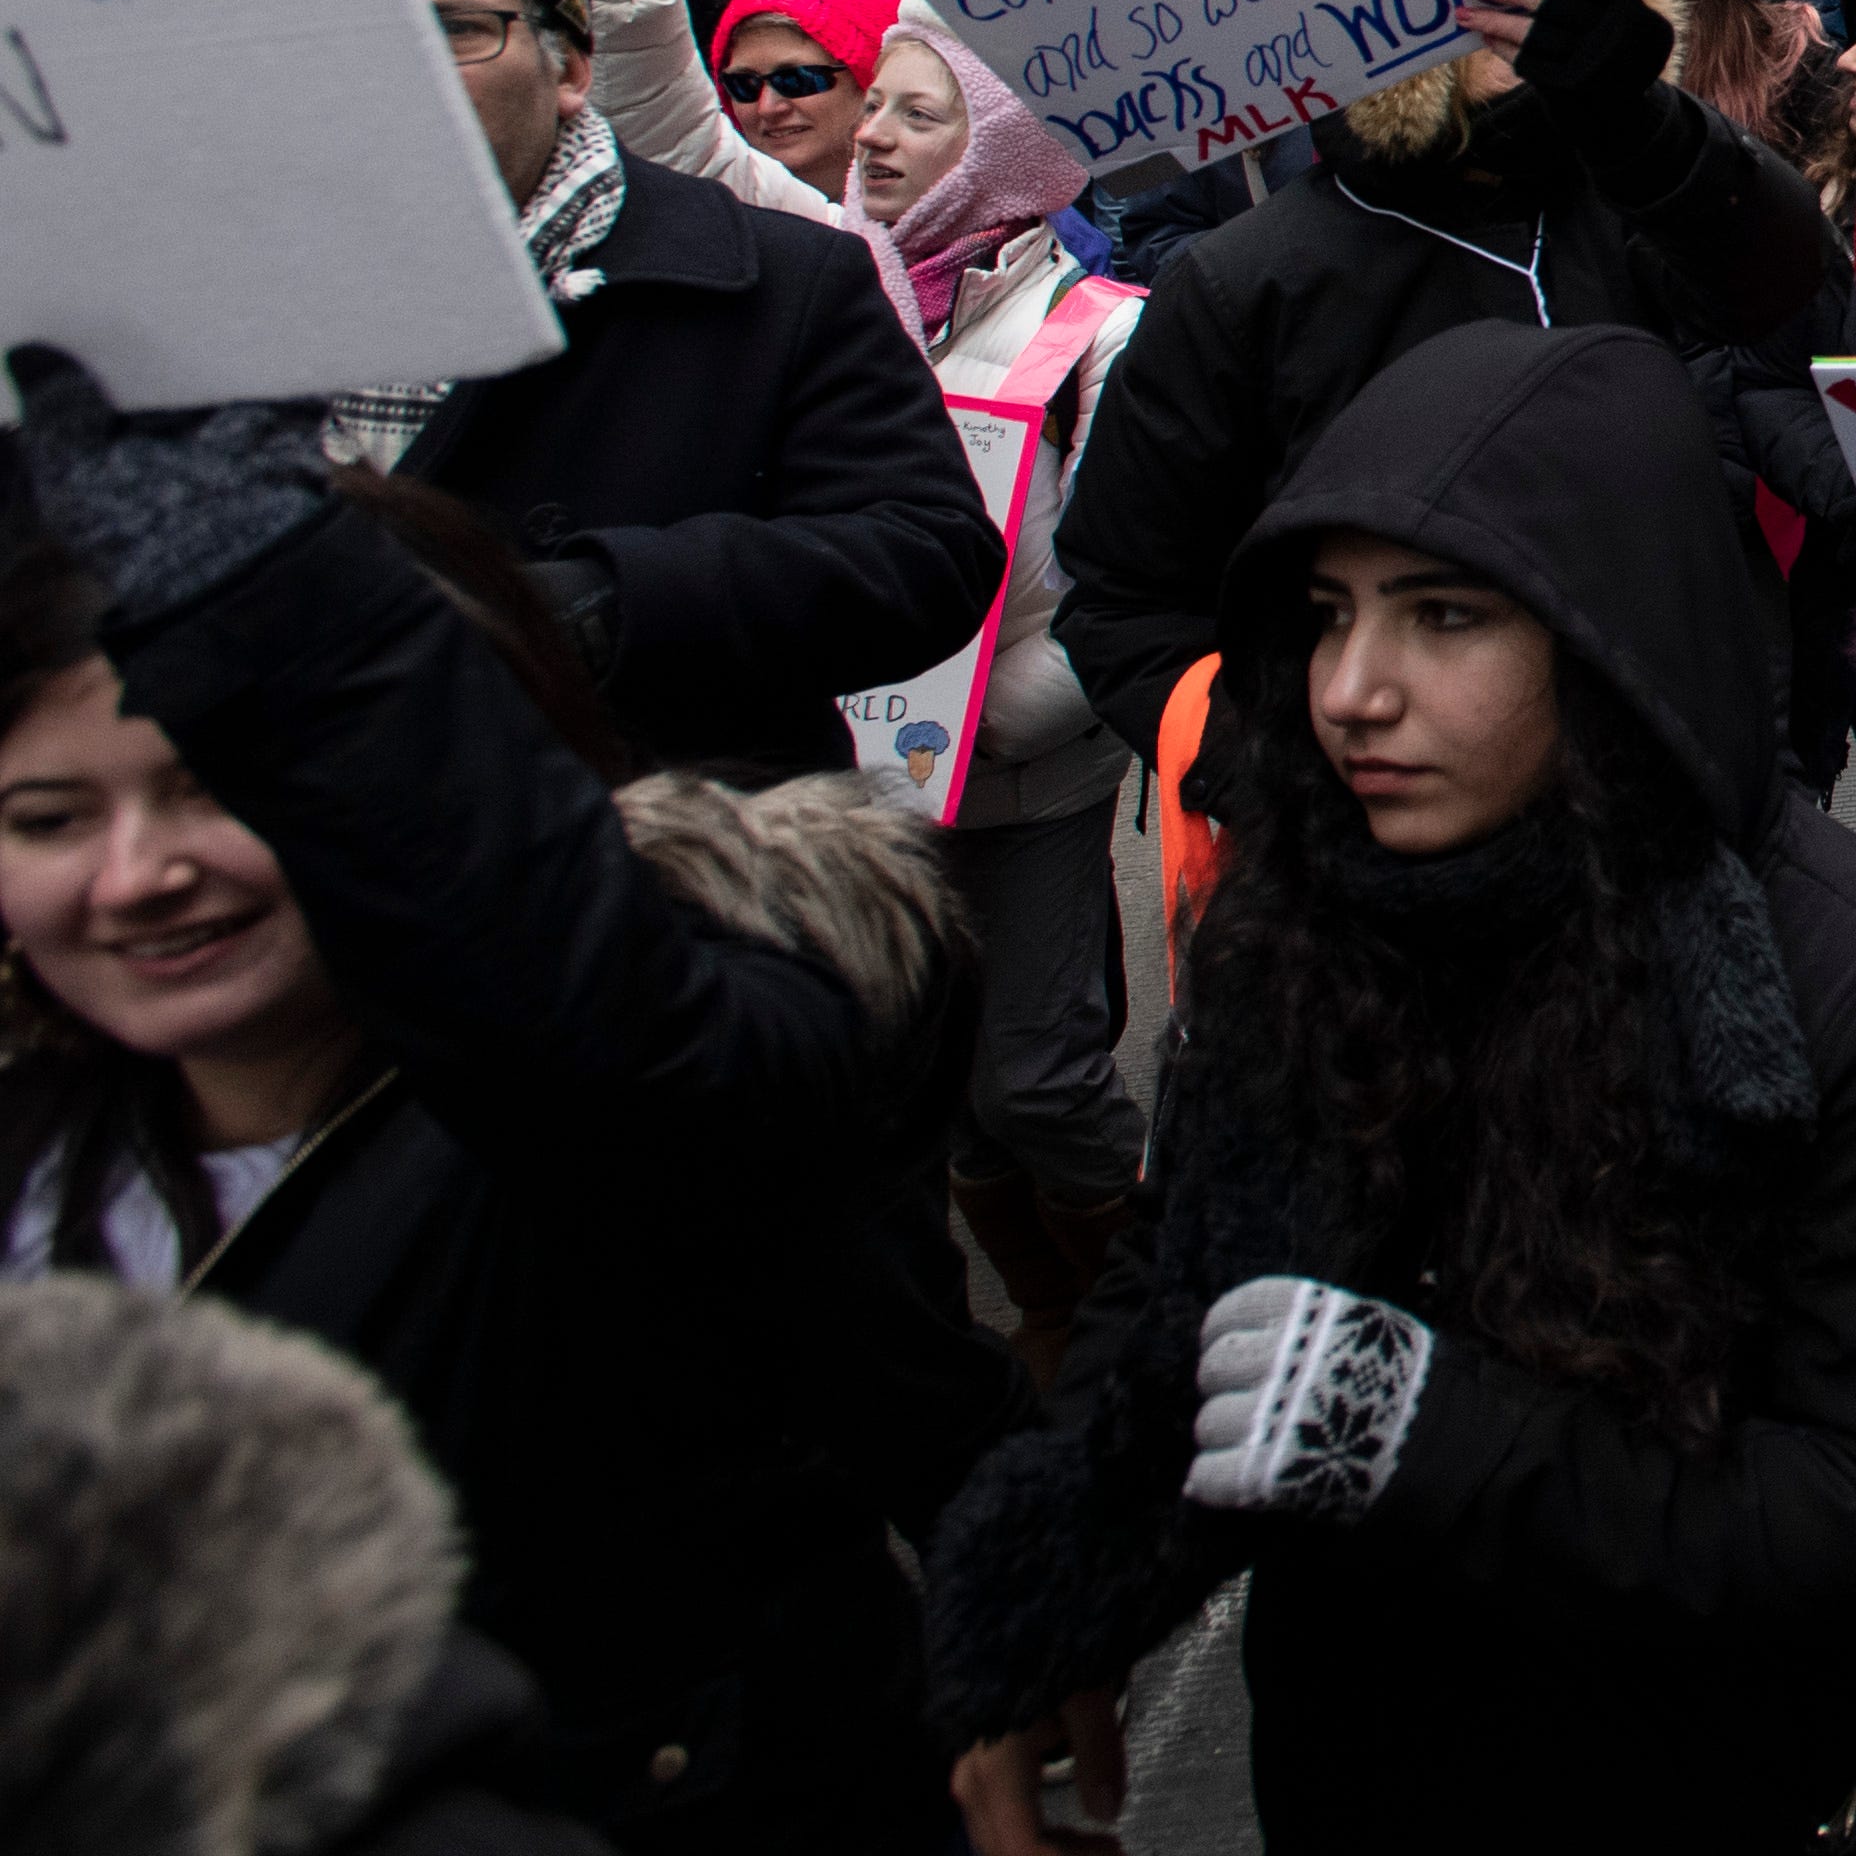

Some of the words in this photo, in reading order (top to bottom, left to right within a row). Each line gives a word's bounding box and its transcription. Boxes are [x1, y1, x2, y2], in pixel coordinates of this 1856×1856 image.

[1021, 4, 1121, 98] and
[1245, 9, 1333, 90] and
[1195, 75, 1340, 163] MLK
